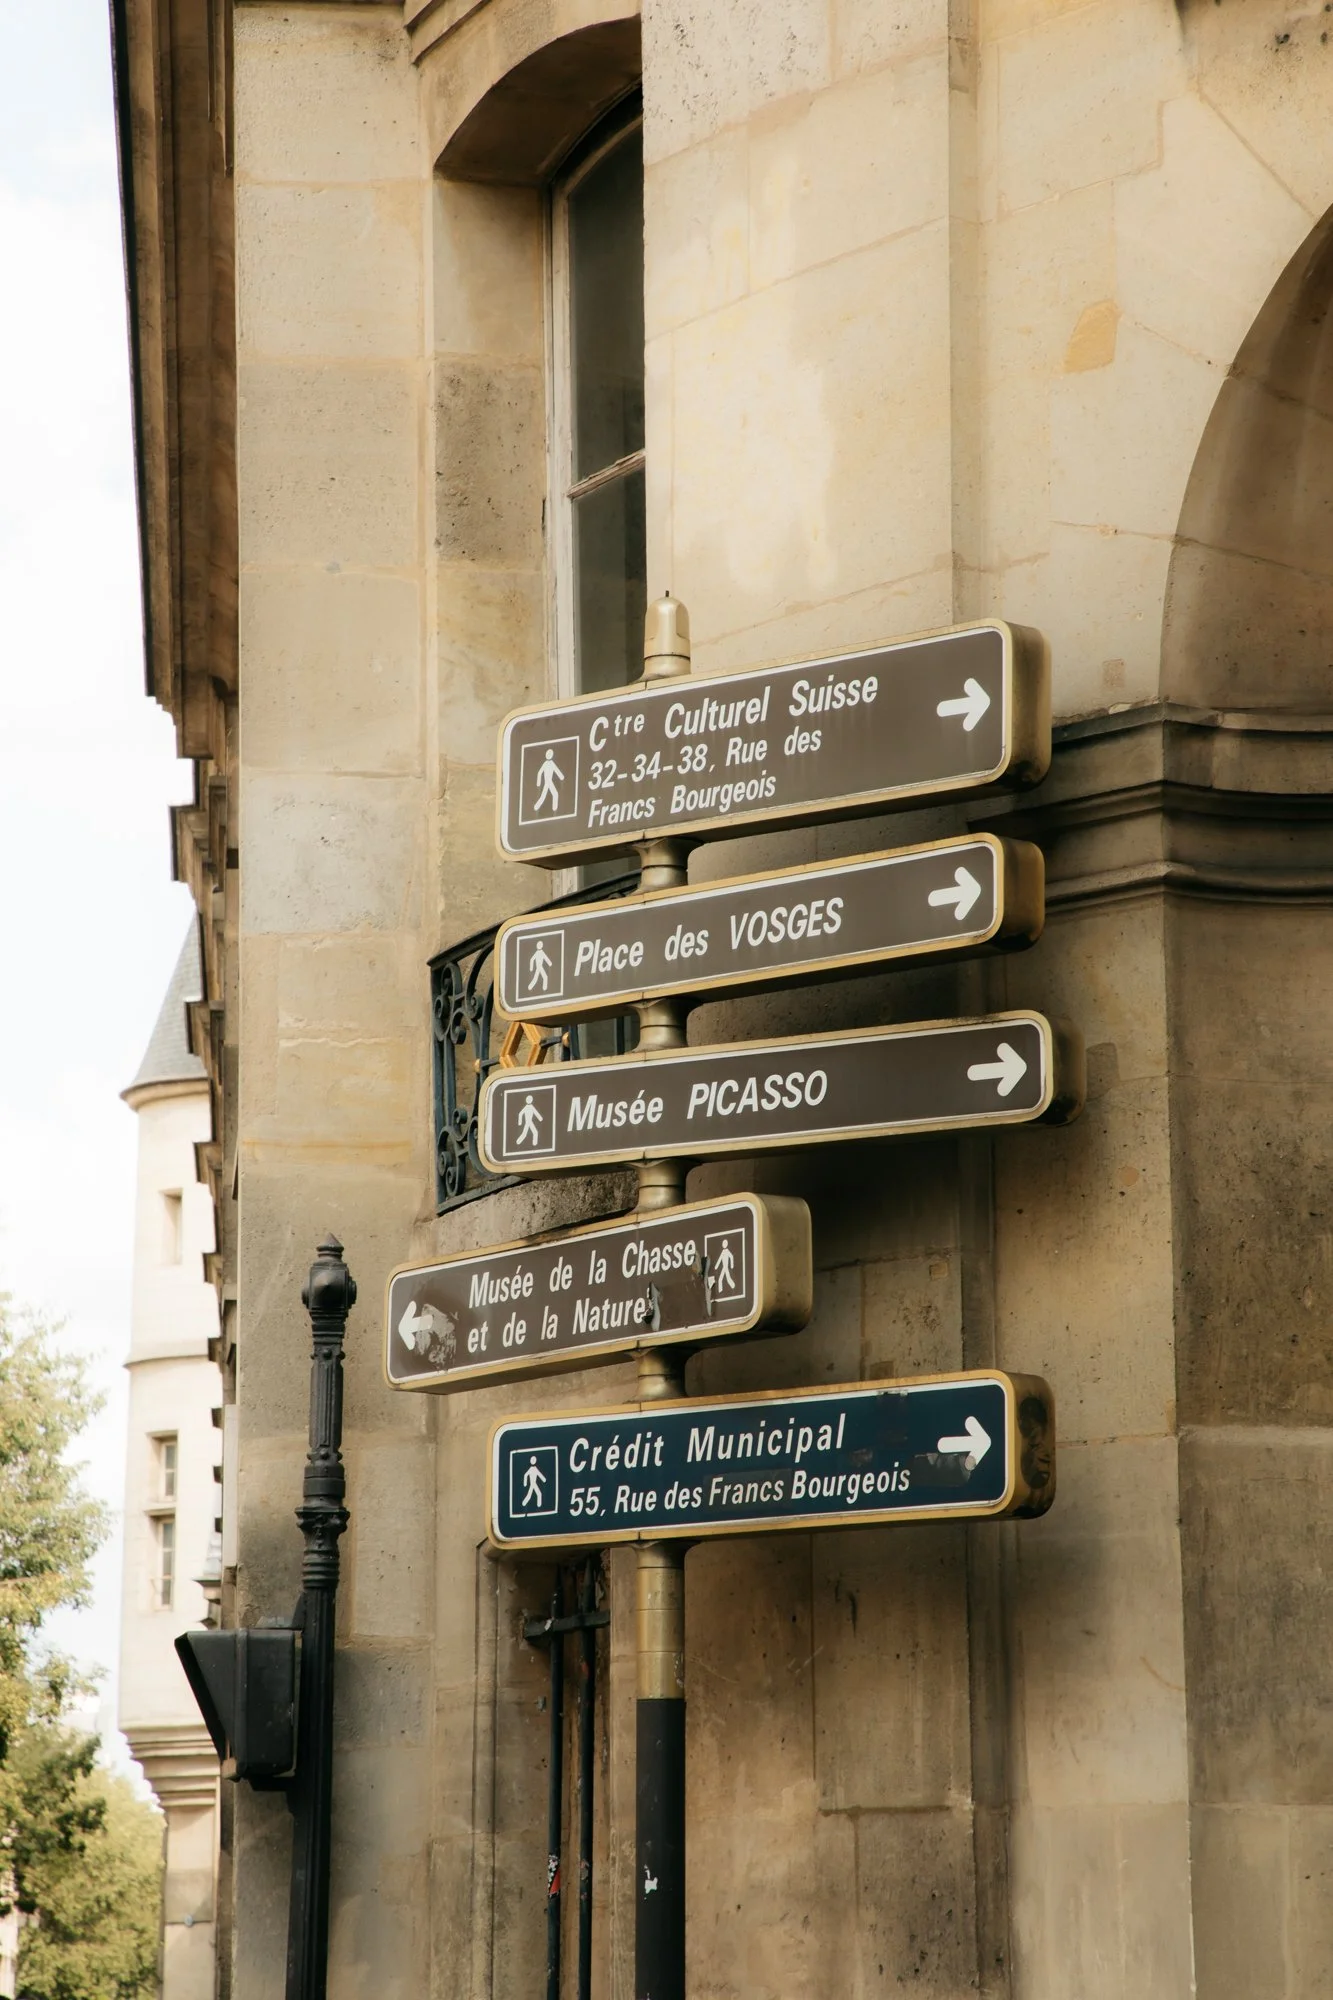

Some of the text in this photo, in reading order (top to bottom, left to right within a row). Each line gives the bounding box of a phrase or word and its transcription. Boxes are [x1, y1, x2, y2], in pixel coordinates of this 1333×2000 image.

[665, 686, 770, 738] Culturel
[789, 675, 878, 716] Suisse
[588, 726, 821, 790] 32-34-38, Rue des
[588, 770, 776, 828] Francs Bourgeois
[574, 897, 843, 976] Place des VOSGES
[567, 1070, 827, 1131] Musée PICASSO
[469, 1240, 696, 1308] Musée de la Chasse
[468, 1298, 646, 1353] et de la Nature
[570, 1413, 845, 1472] Crédit Municipal
[570, 1462, 910, 1516] 55, Rue des Francs Bourgeois
